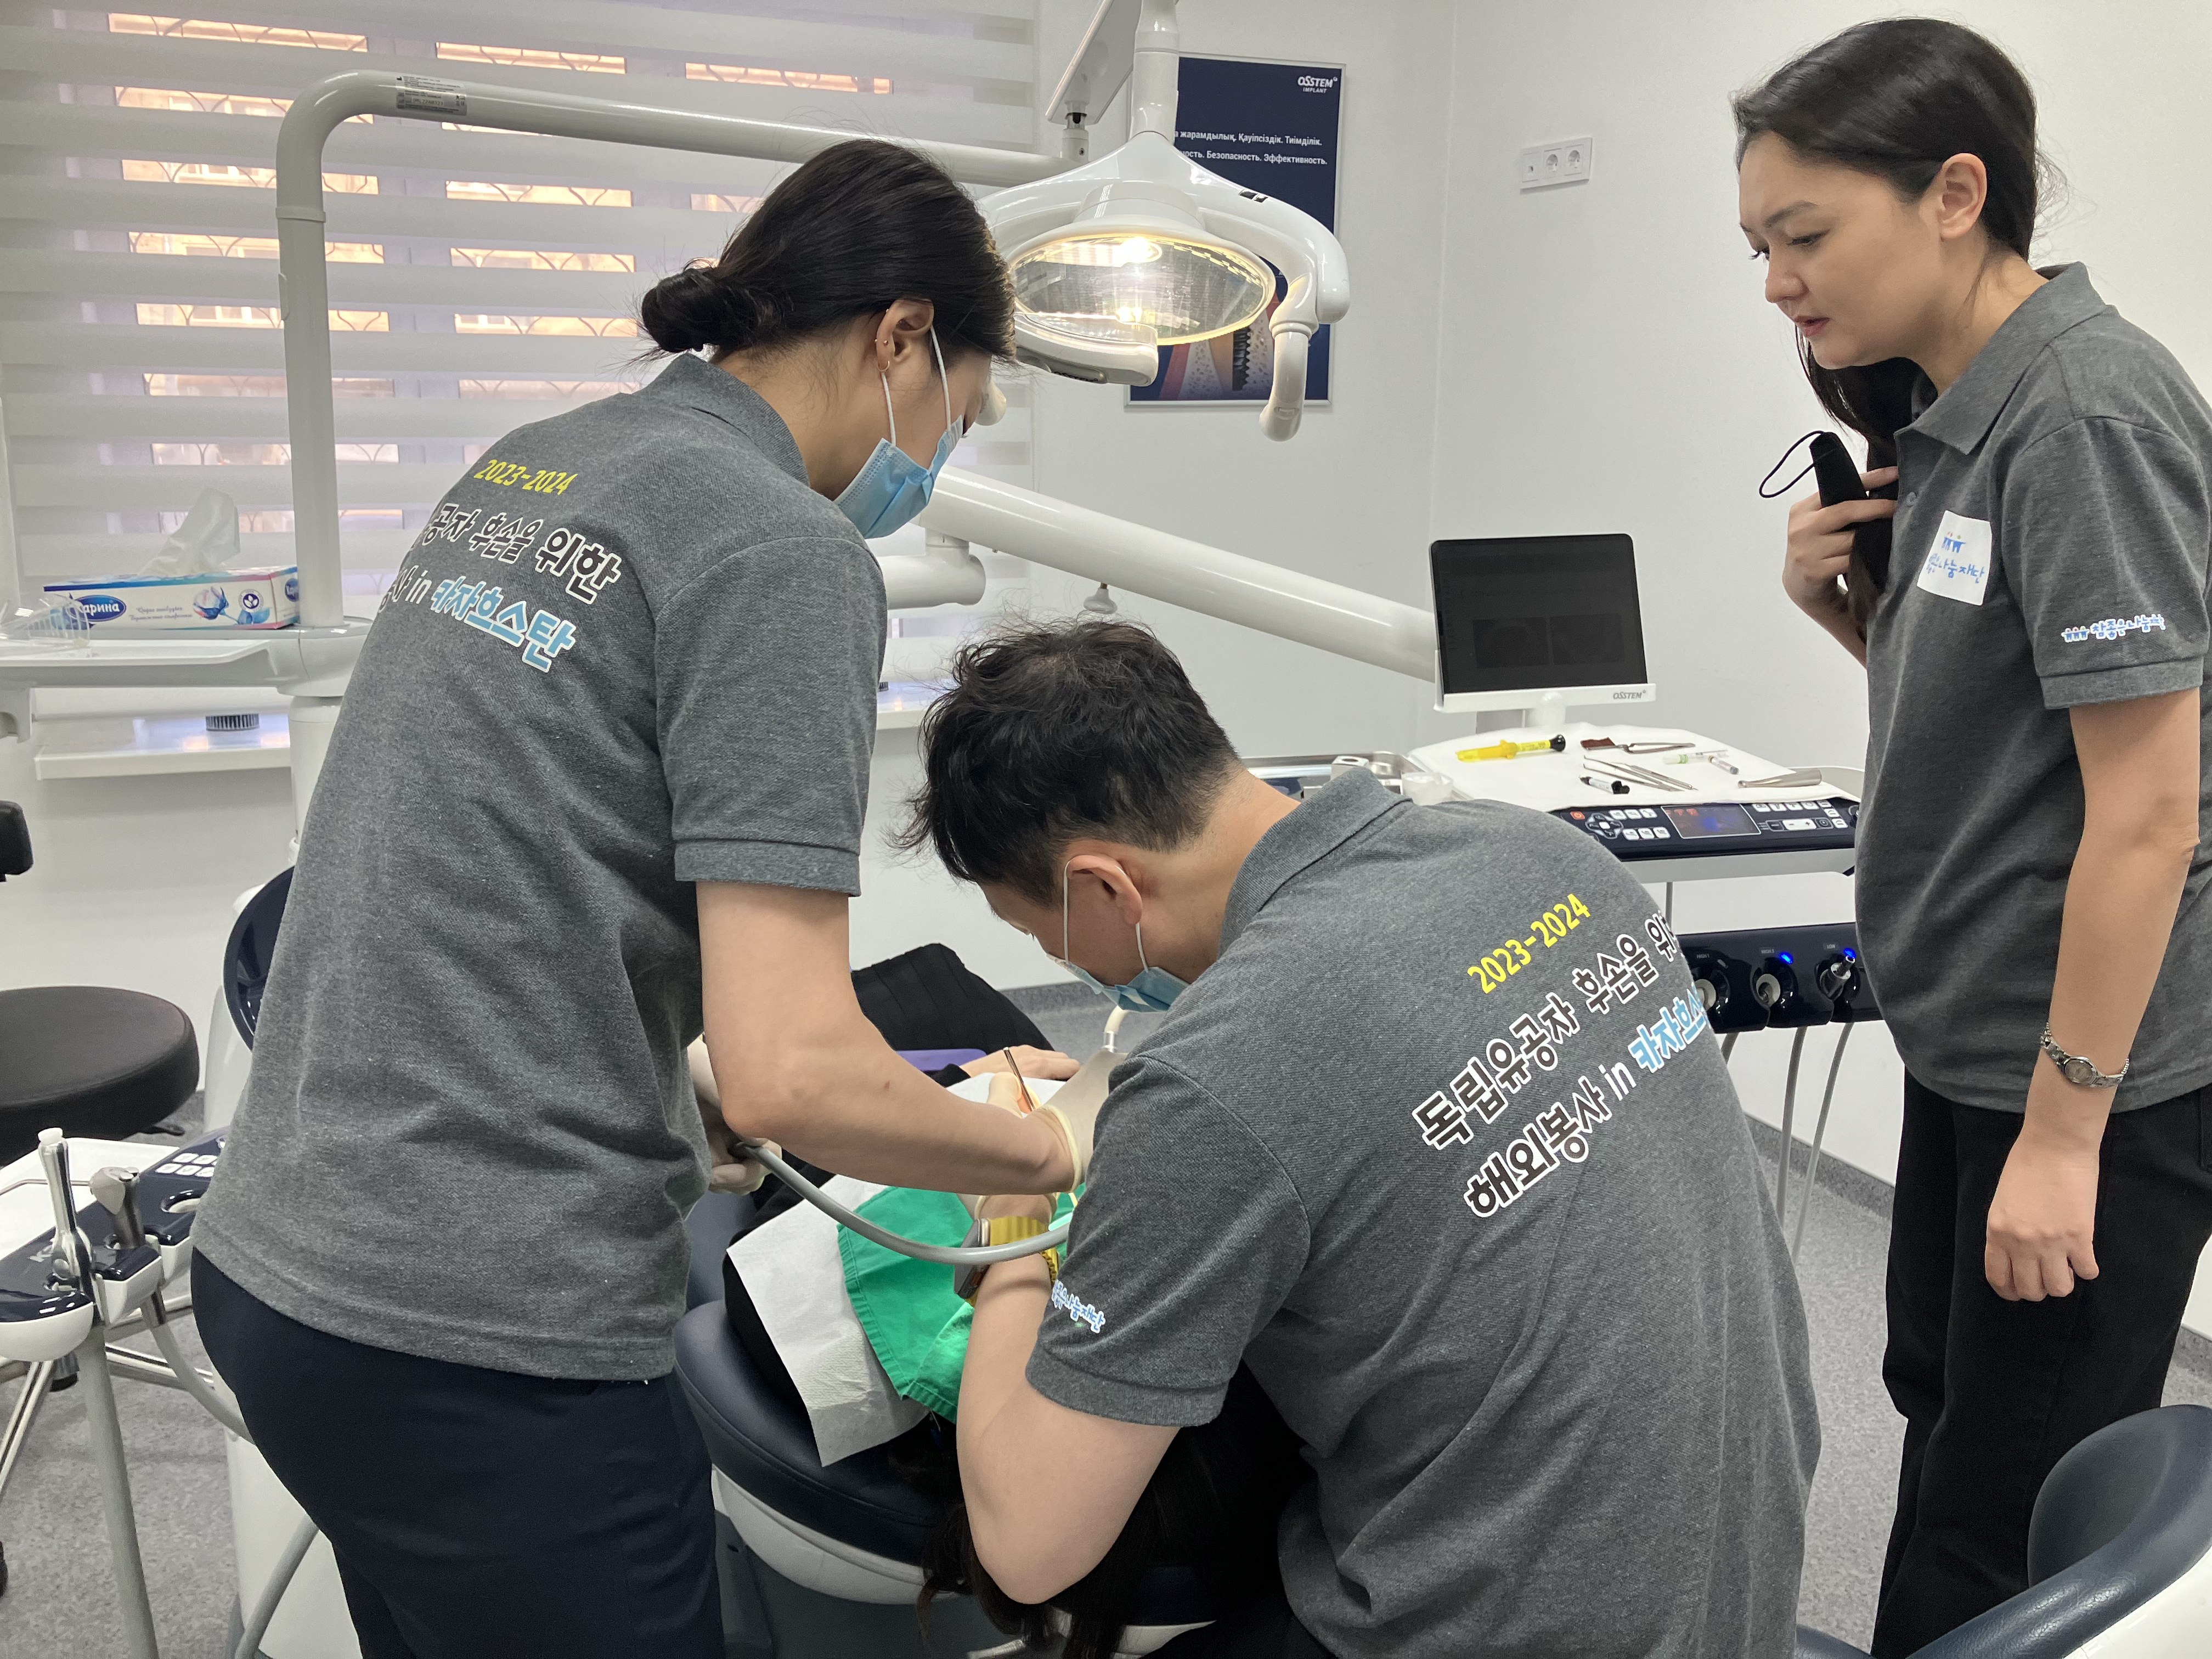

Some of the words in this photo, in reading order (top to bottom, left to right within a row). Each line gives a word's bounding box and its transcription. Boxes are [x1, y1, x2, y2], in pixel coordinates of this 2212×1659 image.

[1297, 76, 1333, 88] OSSTEM
[1206, 150, 1262, 161] Безопасность.
[1263, 154, 1328, 165] Эффективность.
[1285, 136, 1323, 146] Тиімділік.
[474, 459, 578, 495] 2023-2024
[421, 503, 482, 546] 공자
[468, 512, 544, 565] 후손을
[534, 527, 622, 605] 위한
[82, 603, 120, 617] арина
[404, 570, 432, 605] in
[431, 575, 577, 673] 카자흐스탄
[1467, 893, 1590, 994] 2023-2024
[1412, 992, 1581, 1150] 독립유공자
[1571, 934, 1660, 1014] 후손을
[1645, 910, 1680, 963] 위
[1463, 1075, 1612, 1218] 해외봉사
[1598, 1060, 1638, 1101] in
[1627, 981, 1712, 1074] 카자흐스
